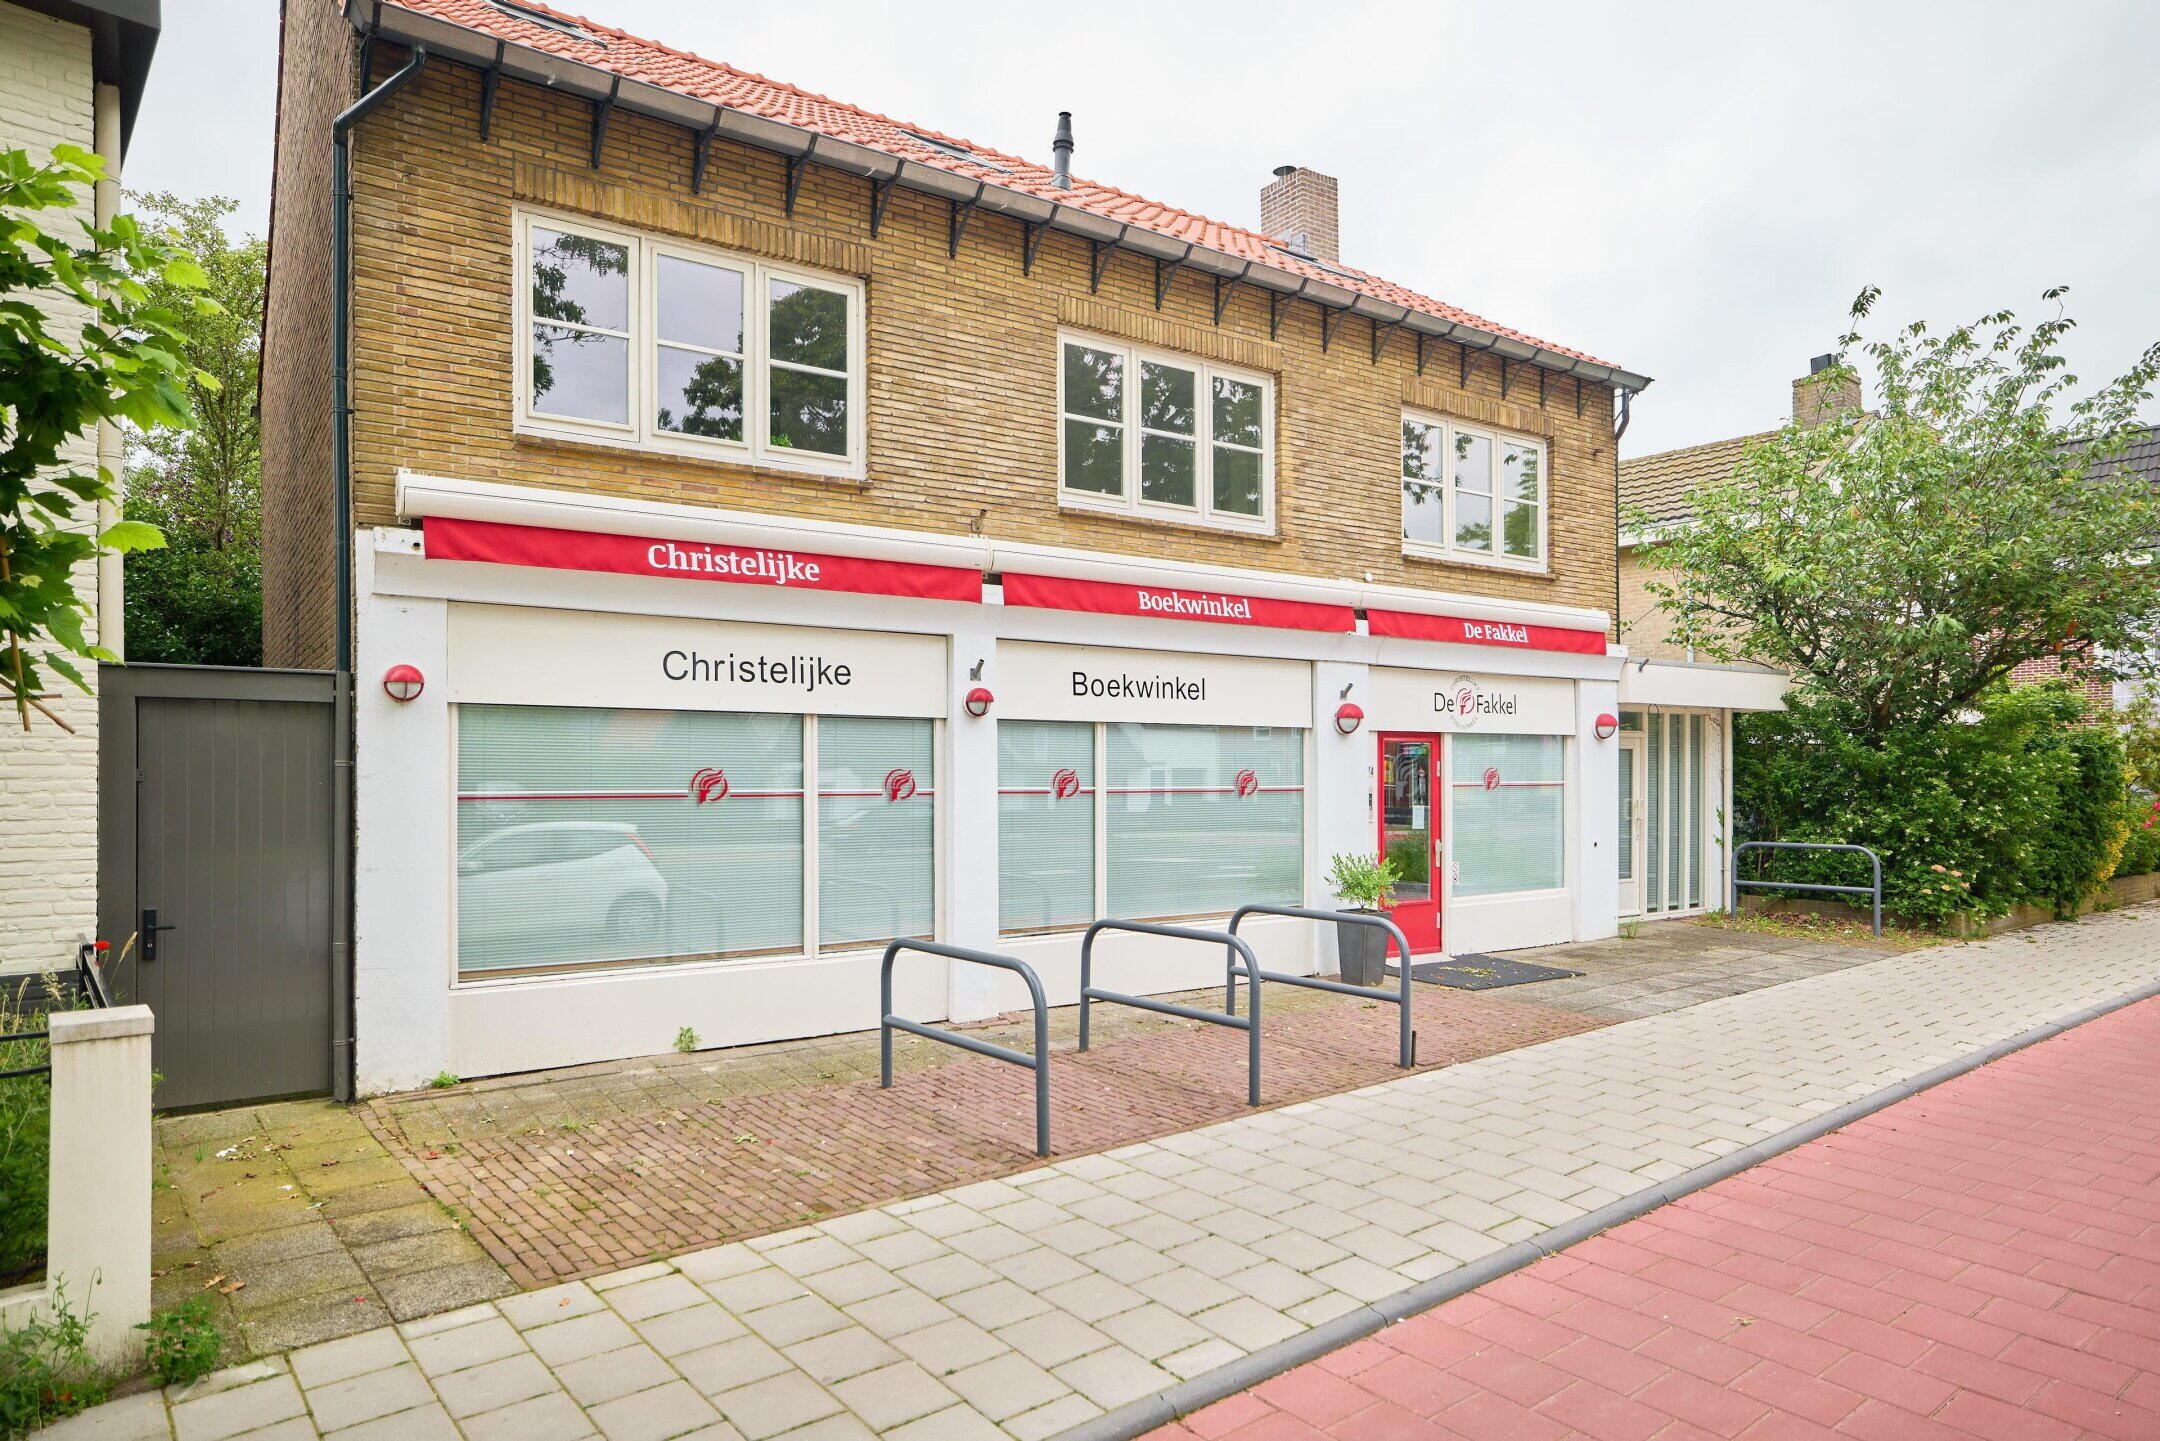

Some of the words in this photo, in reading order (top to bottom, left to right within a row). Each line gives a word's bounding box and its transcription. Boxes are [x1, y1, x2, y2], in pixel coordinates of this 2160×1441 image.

[648, 544, 820, 584] Christelijke
[1137, 591, 1252, 619] Boekwinkel
[1463, 622, 1483, 639] De
[1484, 624, 1529, 643] Fakkel
[662, 650, 851, 692] Christelijke
[1072, 672, 1205, 700] Boekwinkel
[1434, 693, 1454, 712] De
[1477, 693, 1516, 714] Fakkel
